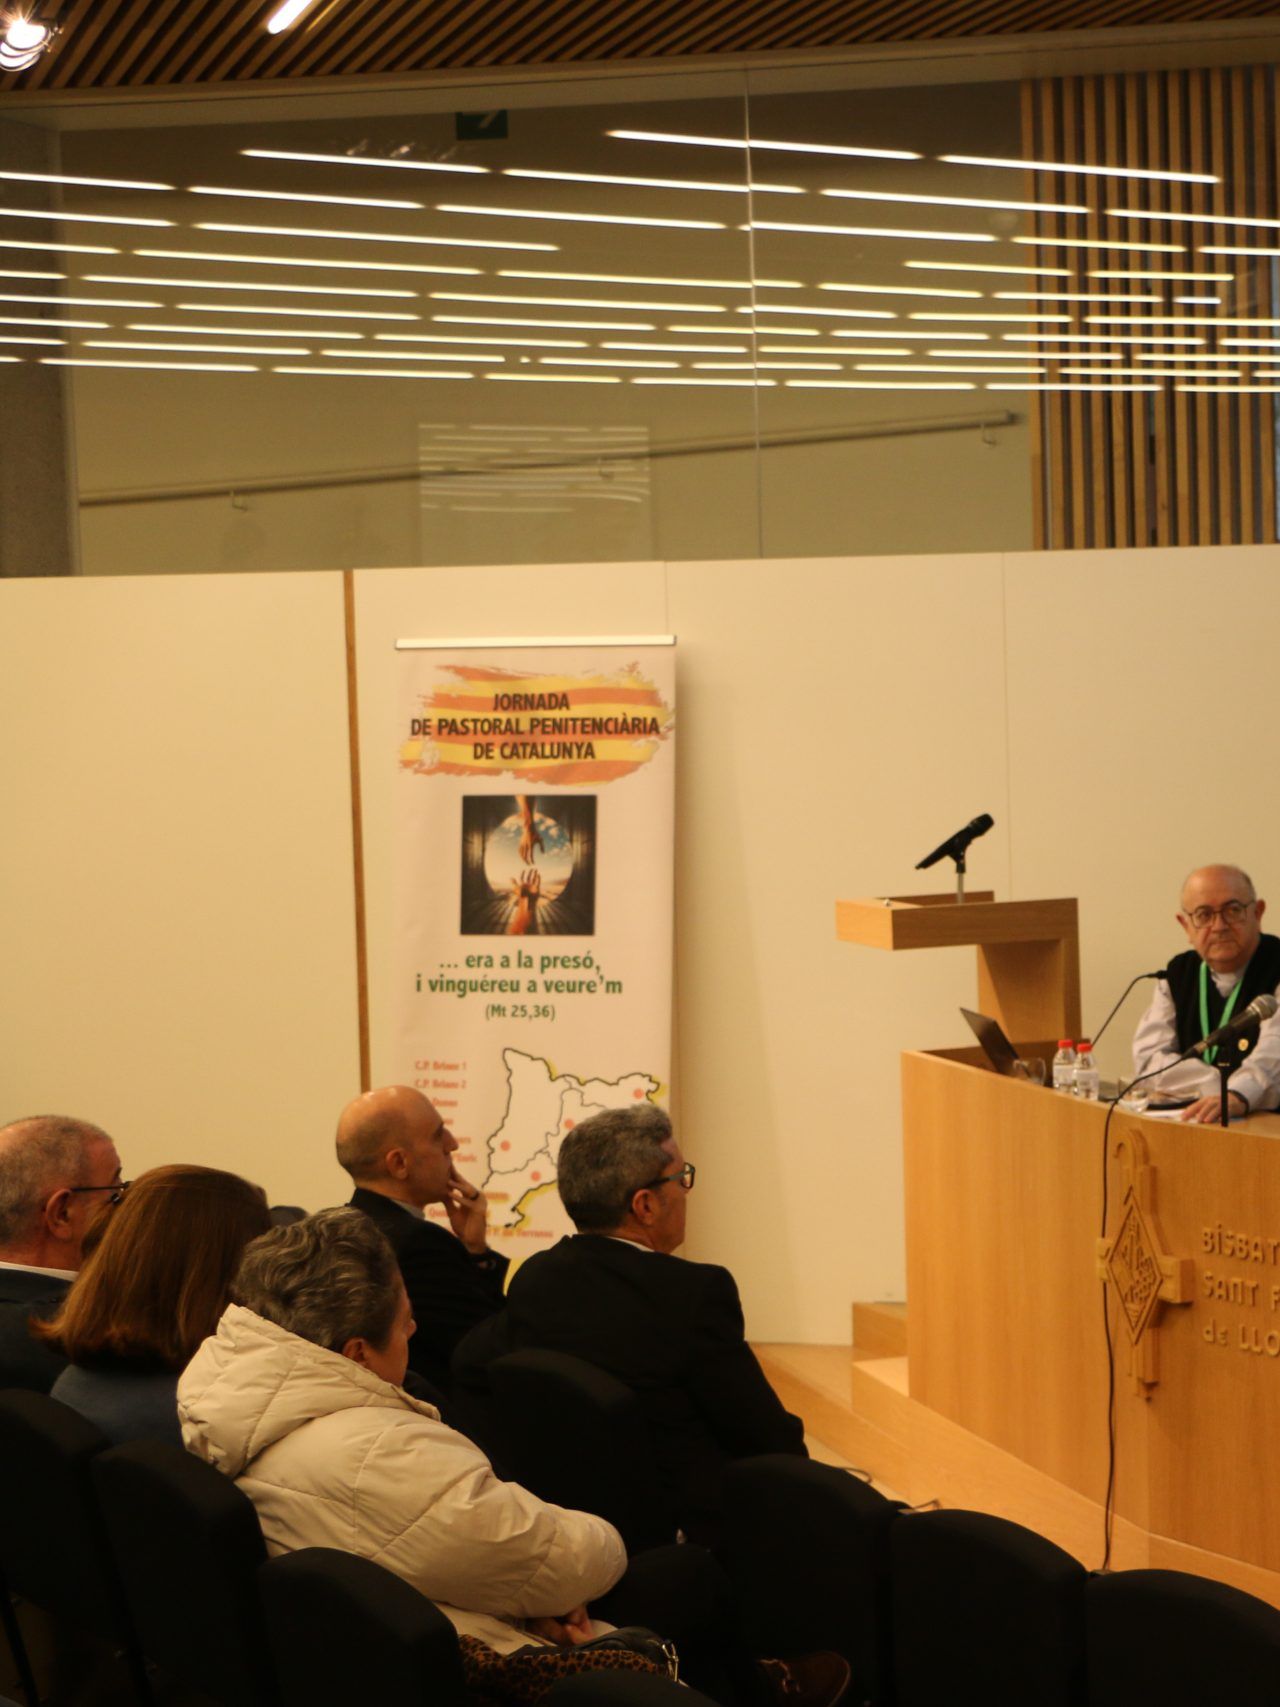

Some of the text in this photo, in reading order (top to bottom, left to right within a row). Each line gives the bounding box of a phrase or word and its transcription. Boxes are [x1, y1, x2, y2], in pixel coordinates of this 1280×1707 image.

[493, 693, 570, 712] JORNADA
[411, 712, 661, 736] DE PASTORAL PENITENCIÀRIA
[473, 741, 596, 760] DE CATALUNYA
[465, 954, 494, 969] era
[500, 955, 510, 969] a
[517, 950, 533, 969] la
[540, 950, 601, 975] presó,
[415, 974, 623, 998] i vinguéreu a veure'm
[485, 1004, 556, 1021] (Mt 25,36)
[1204, 1270, 1259, 1307] SANT
[1203, 1319, 1228, 1346] de
